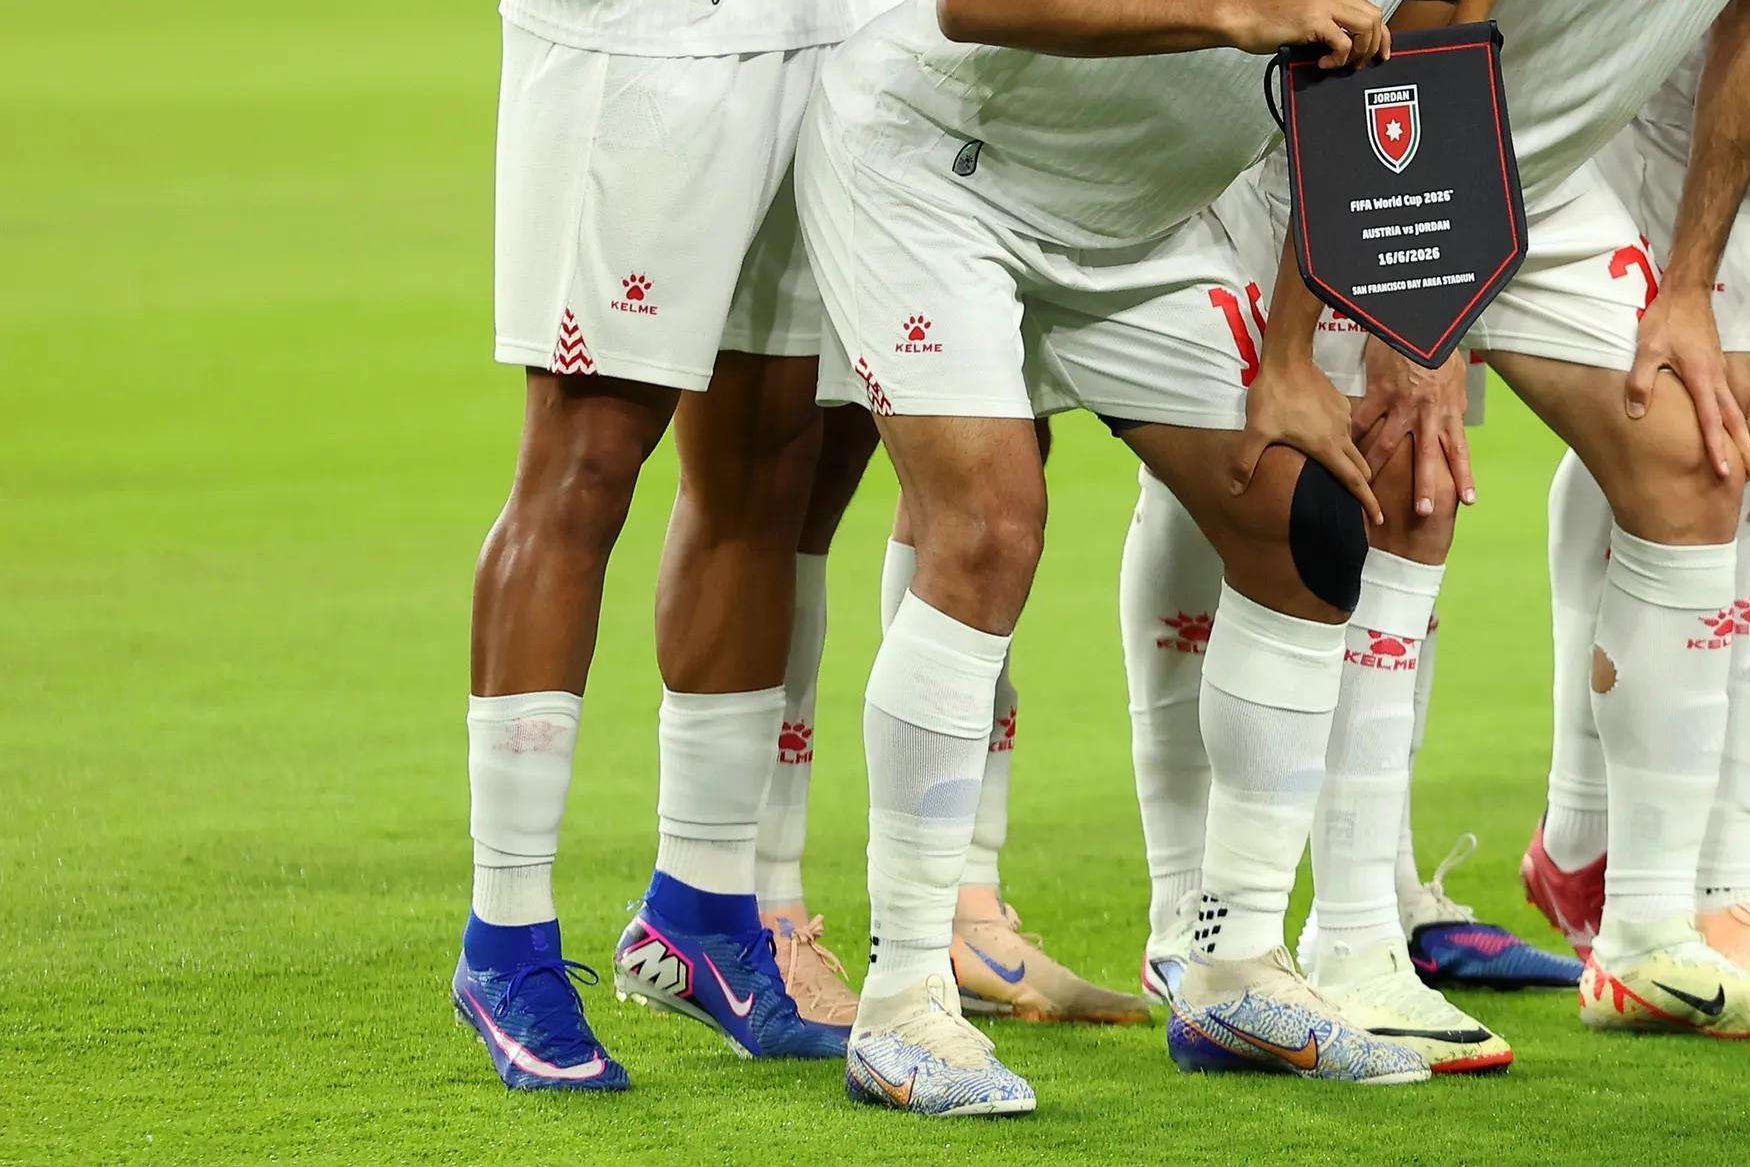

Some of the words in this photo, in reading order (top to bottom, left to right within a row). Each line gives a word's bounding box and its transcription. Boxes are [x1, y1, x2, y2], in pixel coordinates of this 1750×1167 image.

[1373, 89, 1410, 104] JORDAN
[1350, 199, 1373, 212] FIFA
[1373, 194, 1402, 209] World
[1404, 194, 1423, 207] Cup
[1362, 225, 1402, 240] AUSTRIA
[1402, 225, 1414, 235] vs
[1414, 219, 1451, 236] JORDAN
[1378, 246, 1441, 266] 16/6/2026
[1351, 285, 1368, 296] SAN
[1368, 280, 1407, 294] FRANCISCO
[1407, 278, 1422, 290] BAY
[1422, 276, 1443, 288] AREA
[1443, 273, 1476, 285] STADIUM
[1608, 234, 1659, 323] 2
[610, 300, 658, 315] KELME
[1208, 281, 1267, 387] 1
[895, 343, 943, 353] KELME
[1686, 639, 1732, 649] KEL
[1343, 648, 1417, 671] KELME
